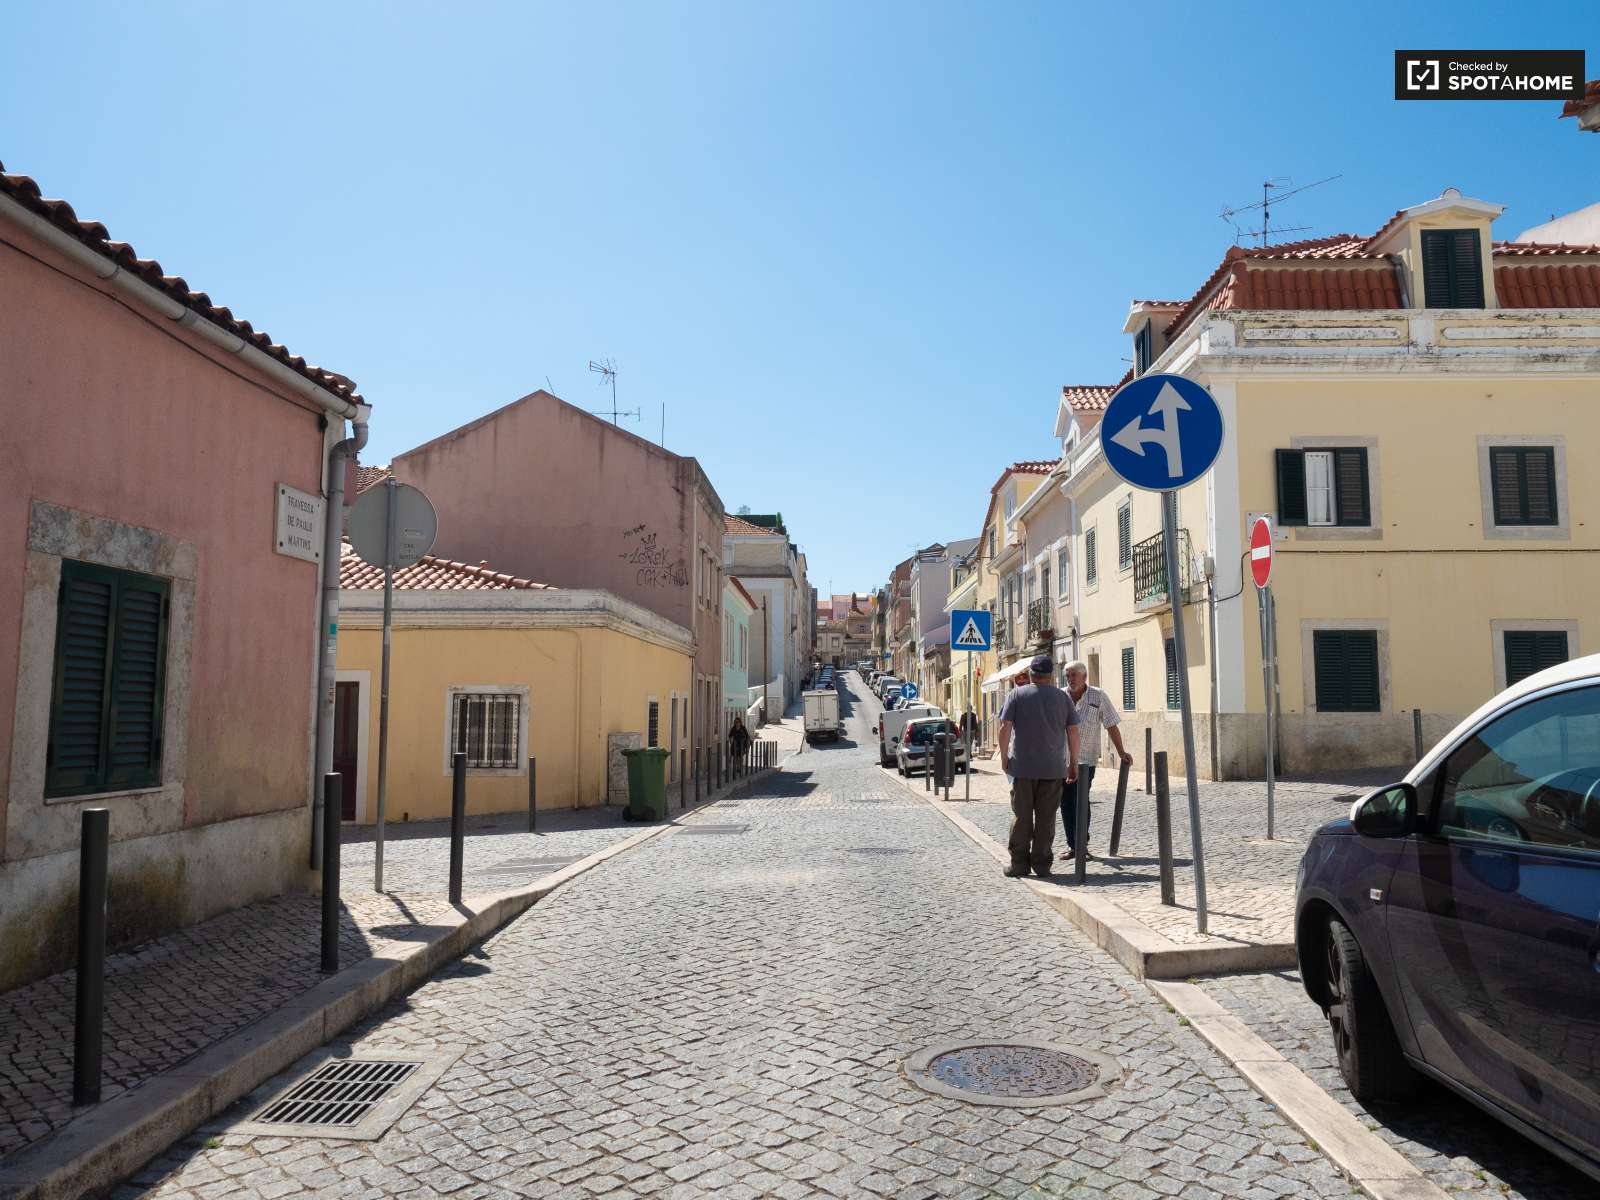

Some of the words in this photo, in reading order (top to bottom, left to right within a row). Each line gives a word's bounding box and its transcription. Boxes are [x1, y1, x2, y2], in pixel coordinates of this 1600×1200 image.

[287, 496, 314, 513] TRAVESSA
[287, 515, 295, 528] DE
[287, 535, 311, 551] MARTINS
